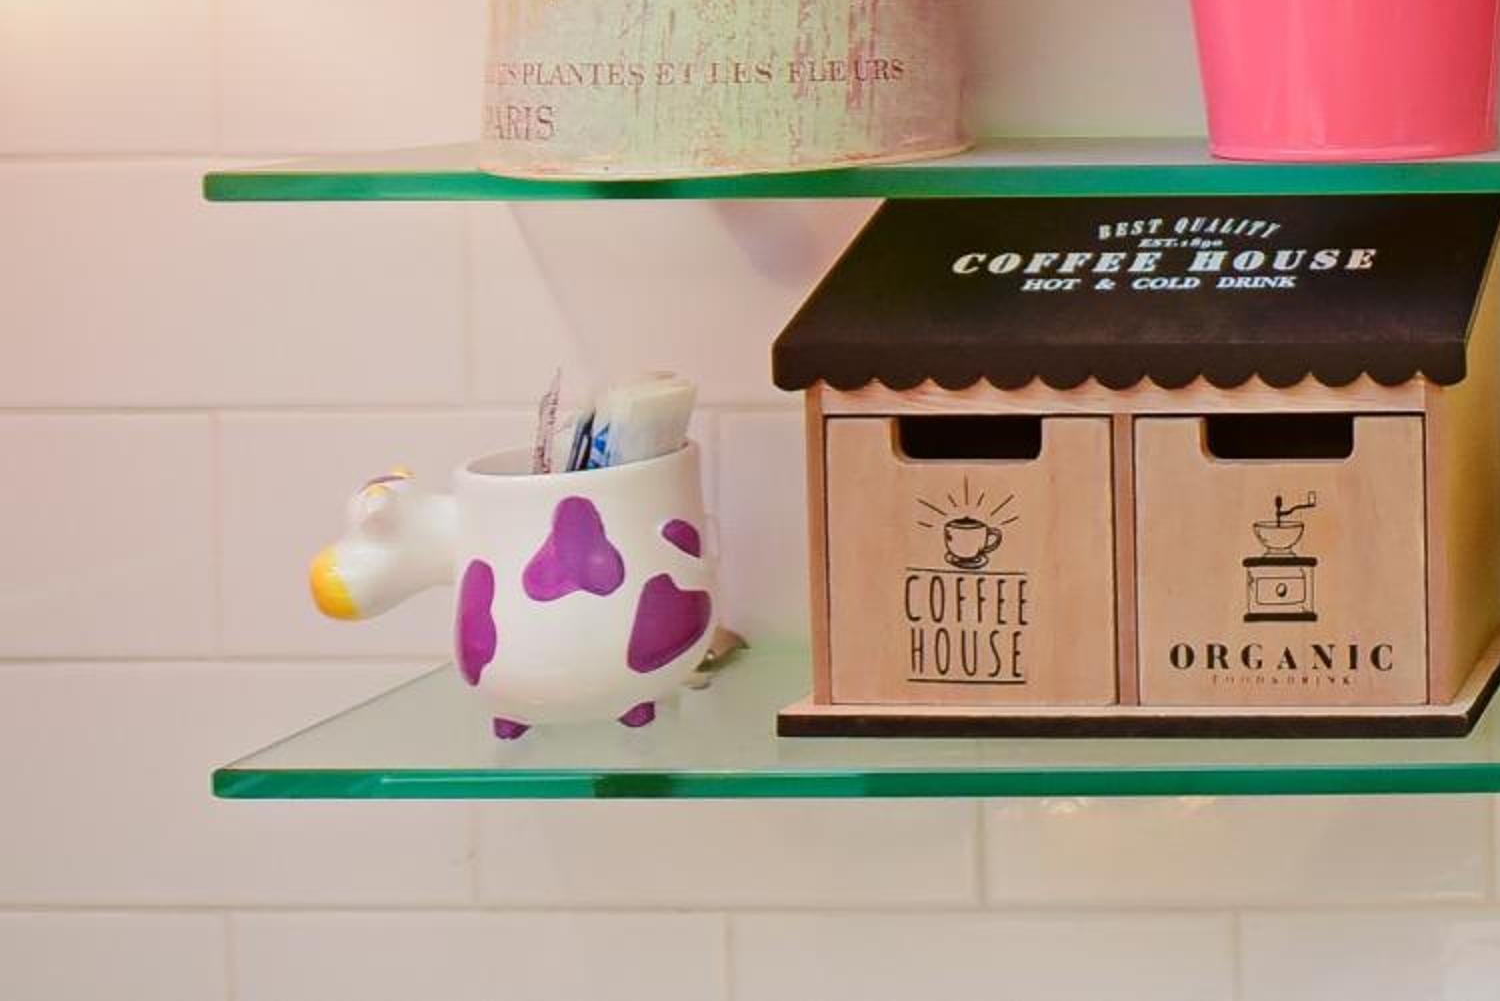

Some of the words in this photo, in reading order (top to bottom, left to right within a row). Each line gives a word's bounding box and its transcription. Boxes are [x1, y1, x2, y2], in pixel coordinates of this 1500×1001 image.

[786, 57, 905, 84] FLEURS
[1098, 218, 1163, 240] BEST
[1173, 216, 1281, 239] QUALITY
[951, 251, 1163, 275] COFFEE
[1187, 248, 1377, 272] HOUSE
[1020, 277, 1082, 292] HOT
[1094, 277, 1116, 291] &
[1131, 277, 1201, 291] COLD
[1215, 275, 1297, 290] DRINK
[905, 574, 1028, 626] COFFEE
[911, 627, 1022, 678] HOUSE
[1168, 642, 1394, 672] ORGANIC
